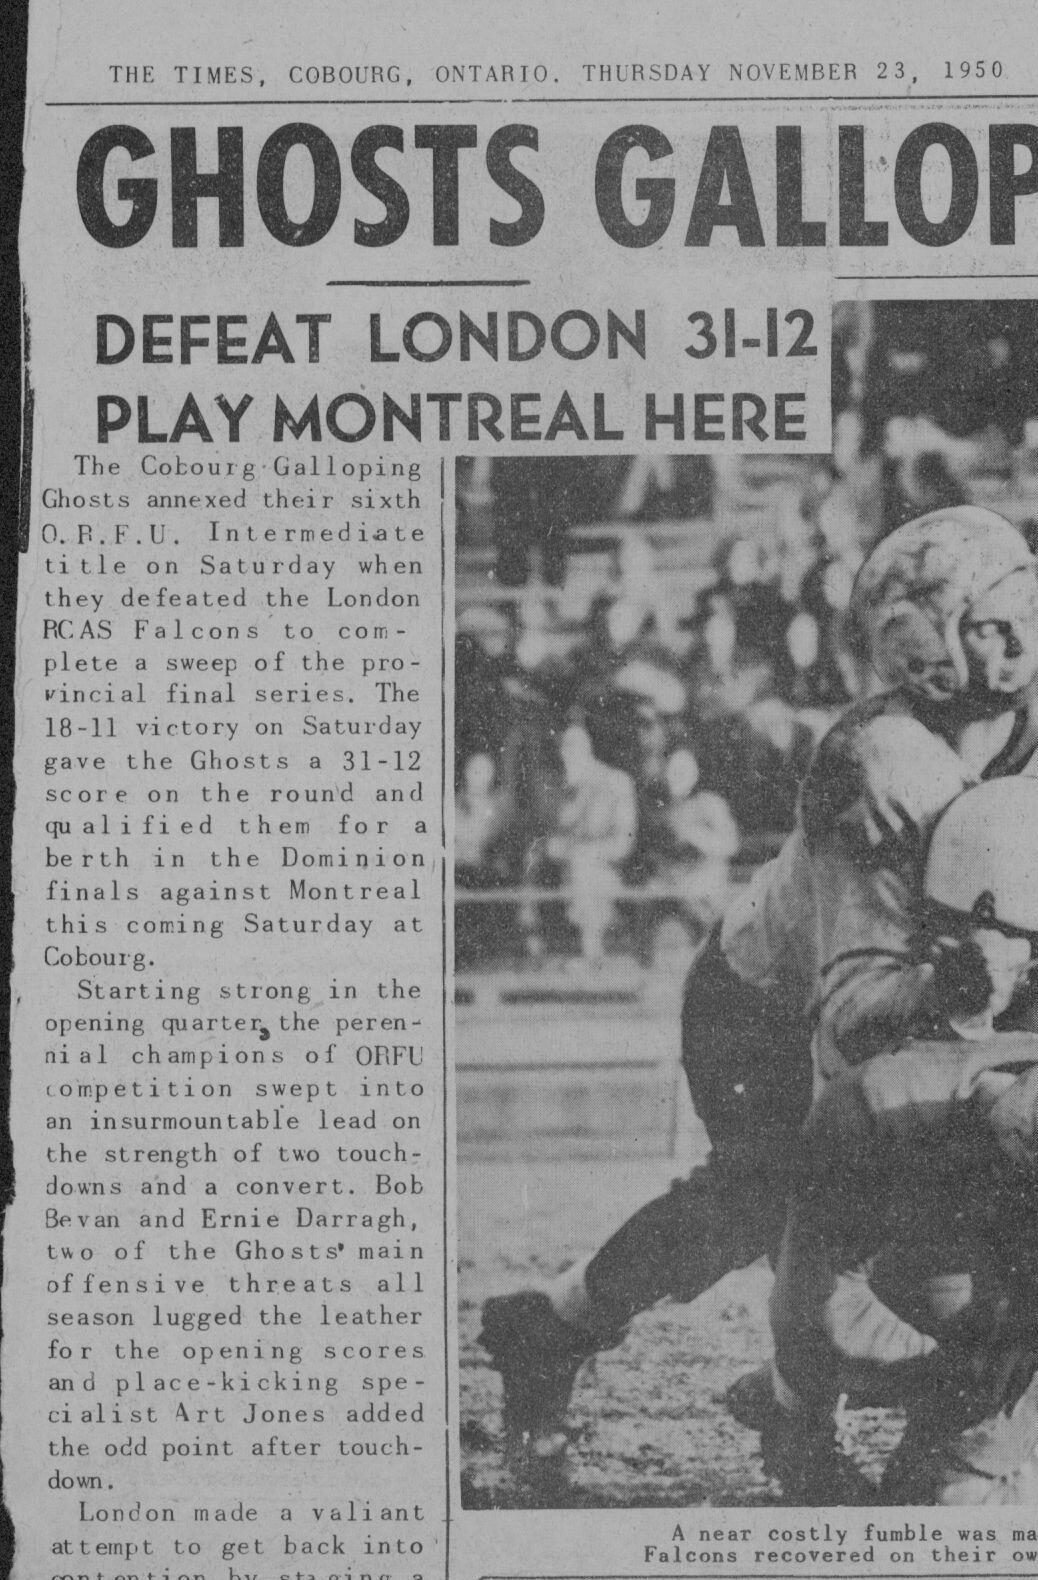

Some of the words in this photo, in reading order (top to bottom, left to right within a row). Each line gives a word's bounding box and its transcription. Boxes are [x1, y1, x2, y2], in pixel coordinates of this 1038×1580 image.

[109, 65, 154, 83] THE
[174, 66, 265, 87] TIMES,
[289, 66, 412, 86] COBOURG,
[436, 65, 558, 83] ONTARIO.
[582, 64, 710, 82] THURSDAY
[730, 63, 856, 81] NOVEMBER
[877, 61, 917, 84] 23,
[945, 60, 1002, 78] 1950
[76, 122, 545, 249] GHOSTS
[96, 311, 331, 365] DEFEAT
[370, 309, 646, 363] LONDON
[685, 308, 817, 359] 31-12
[97, 392, 254, 444] PLAY
[273, 390, 624, 443] MONTREAL
[645, 393, 806, 442] HERE
[74, 454, 120, 475] The
[140, 454, 256, 483] Cobourg
[274, 454, 421, 482] Galloping
[41, 488, 129, 508] Ghosts
[147, 488, 246, 508] annexed
[263, 488, 333, 508] their
[351, 488, 420, 509] sixth
[45, 587, 103, 613] they
[121, 587, 246, 607] defeated
[266, 587, 308, 607] the
[328, 586, 419, 607] London
[77, 979, 200, 1005] Starting
[220, 984, 310, 1004] strong
[330, 979, 357, 999] in
[378, 978, 420, 999] the
[48, 1313, 134, 1326] season
[153, 1305, 241, 1331] lugged
[260, 1304, 301, 1325] the
[321, 1304, 422, 1325] leather
[672, 1524, 685, 1541] A
[700, 1529, 751, 1541] near
[768, 1524, 847, 1546] costly
[865, 1523, 942, 1542] fumble
[958, 1529, 997, 1542] was
[645, 1546, 737, 1563] Falcons
[755, 1546, 874, 1563] recovered
[890, 1552, 914, 1562] on
[932, 1546, 996, 1562] their
